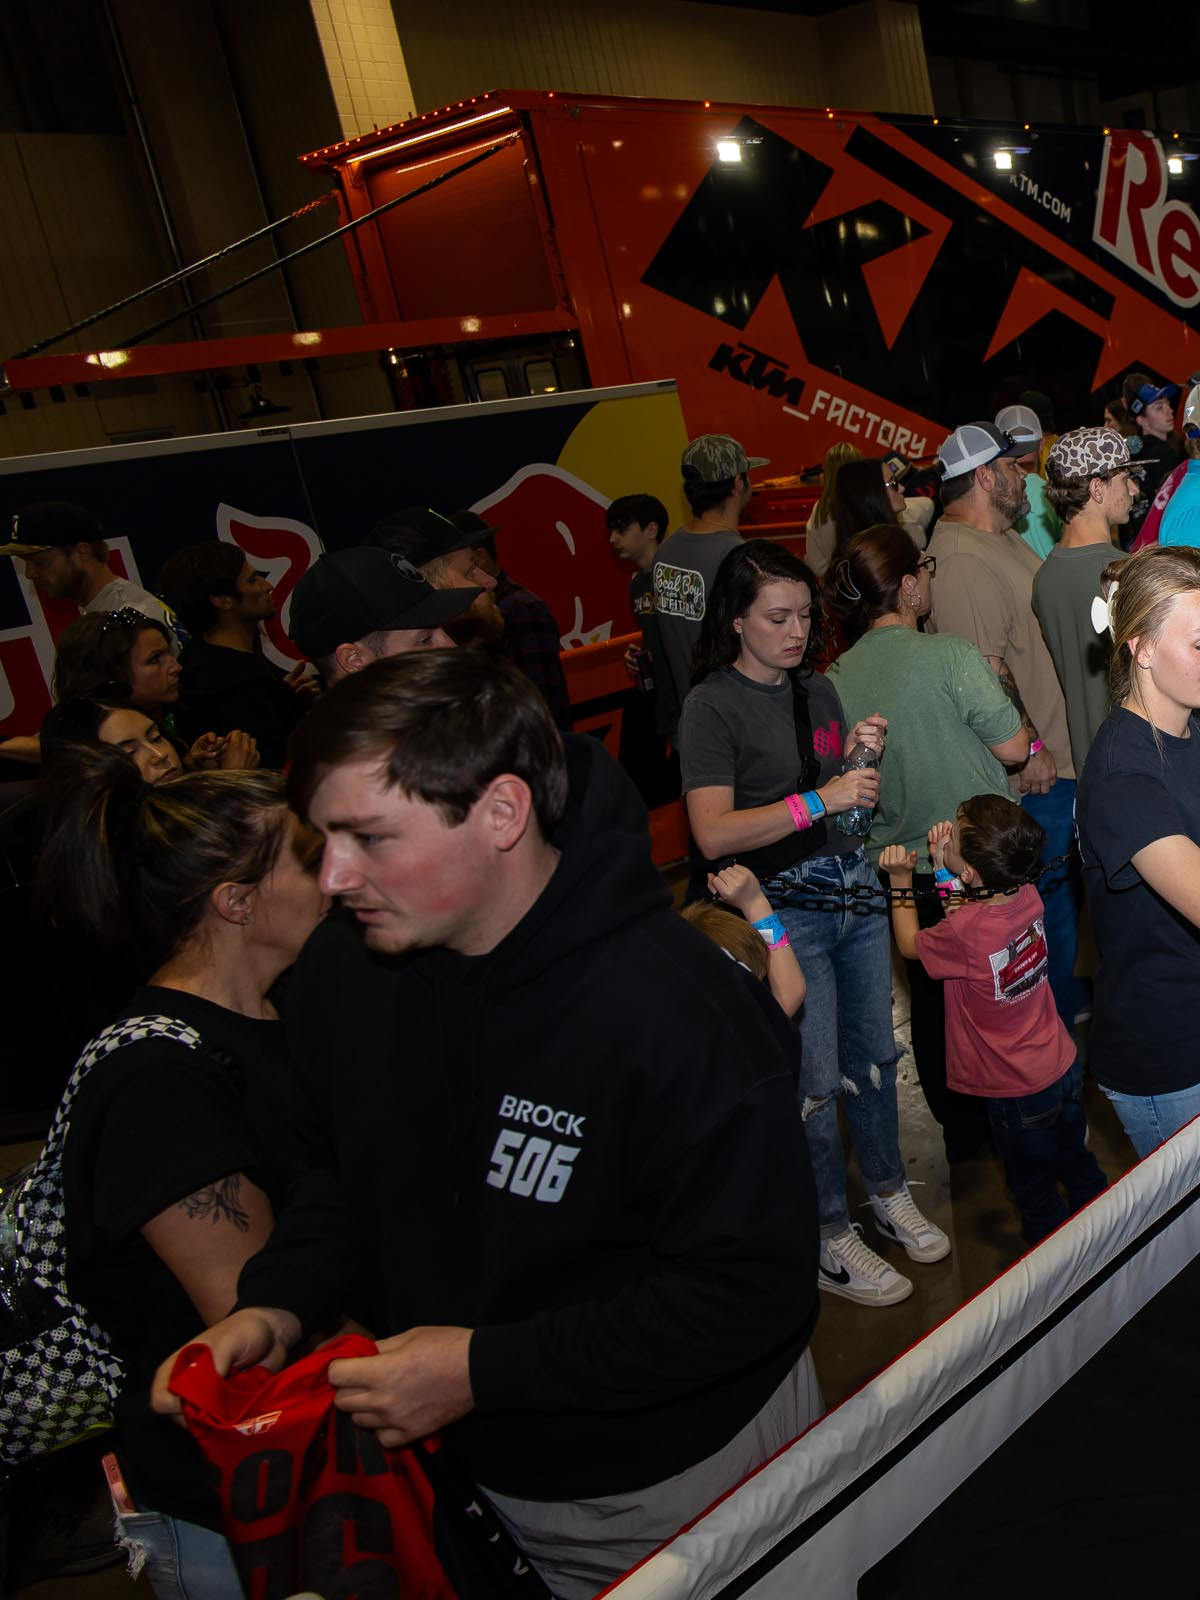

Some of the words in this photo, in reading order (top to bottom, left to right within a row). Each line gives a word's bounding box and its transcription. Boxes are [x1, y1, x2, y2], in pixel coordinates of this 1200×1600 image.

[708, 342, 806, 407] KTM
[655, 567, 681, 593] Local
[682, 574, 702, 604] Boy
[498, 1094, 587, 1138] BROCK
[486, 1128, 581, 1203] 506
